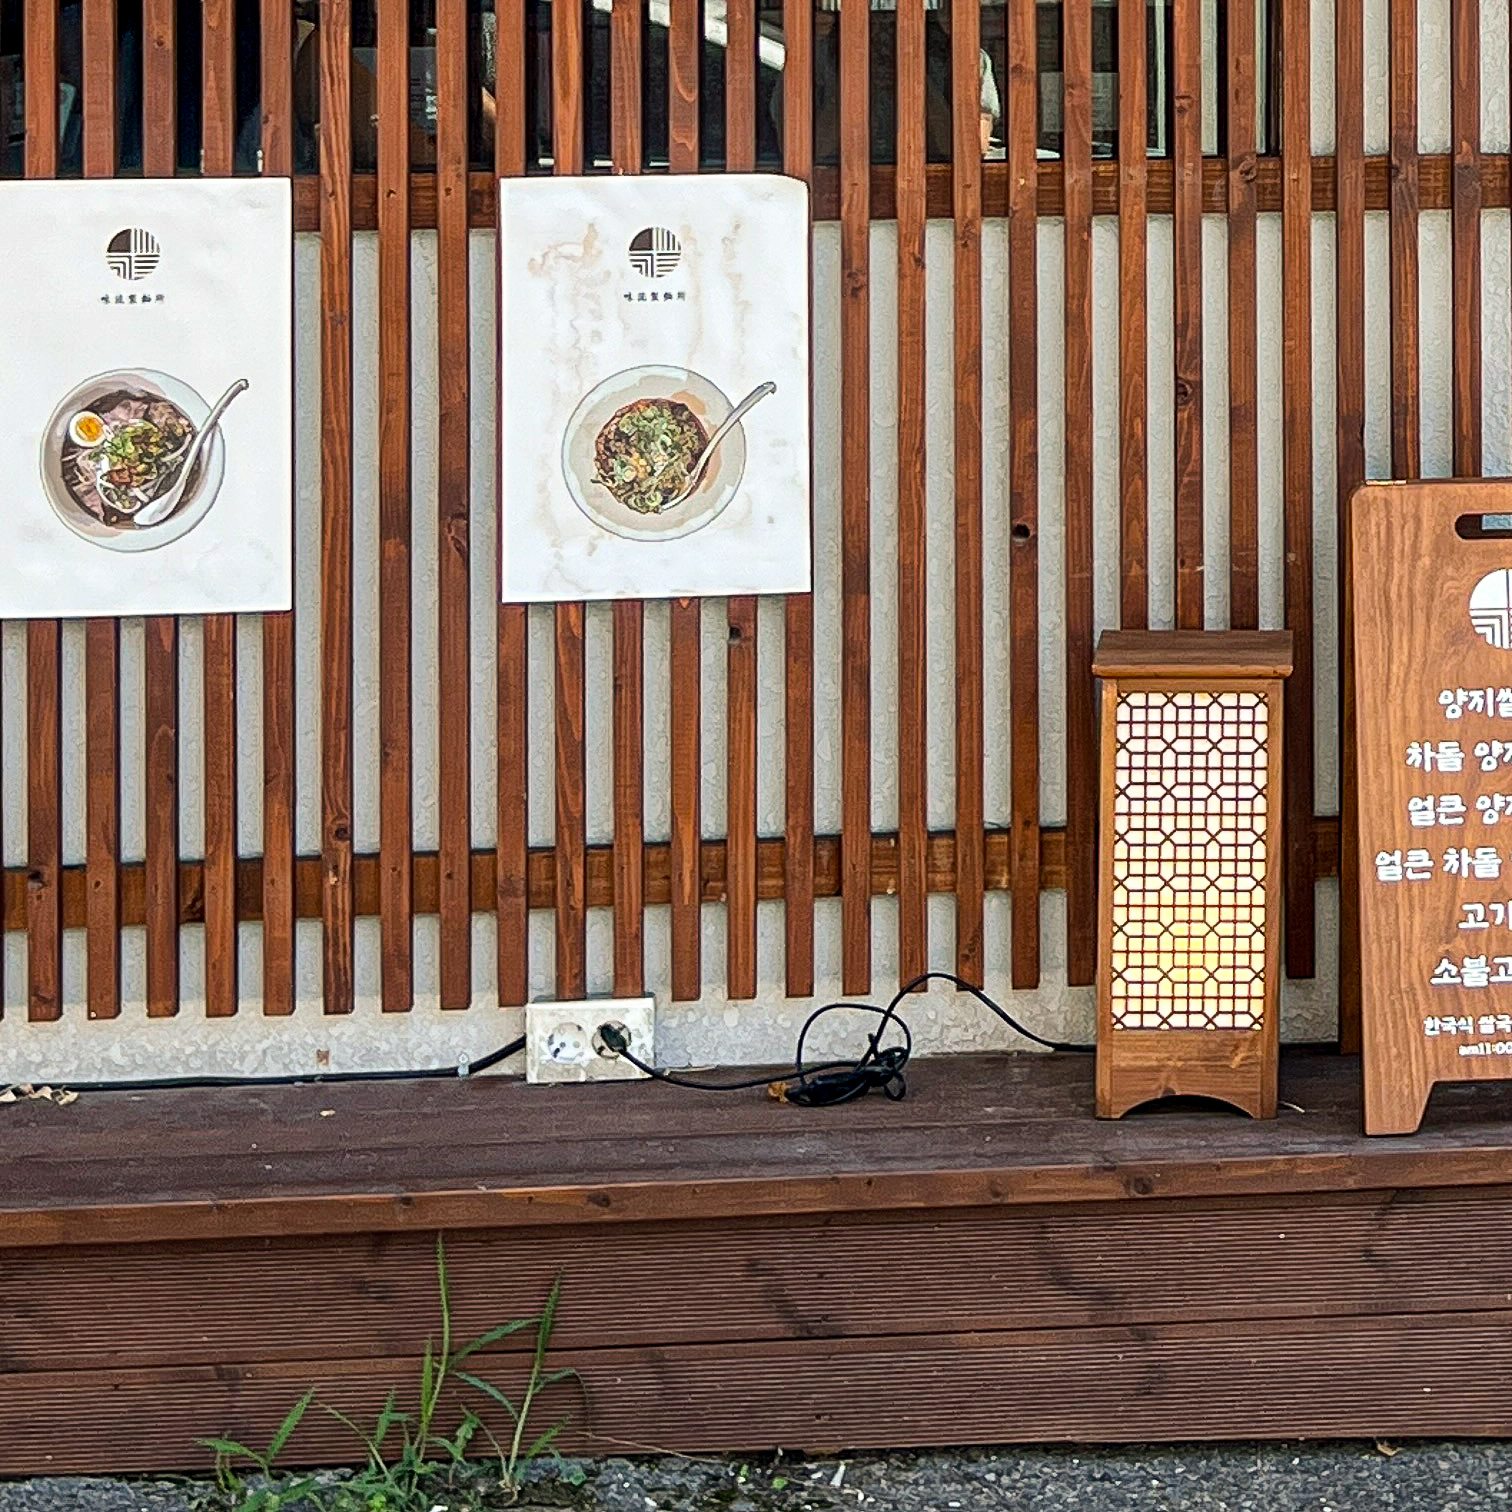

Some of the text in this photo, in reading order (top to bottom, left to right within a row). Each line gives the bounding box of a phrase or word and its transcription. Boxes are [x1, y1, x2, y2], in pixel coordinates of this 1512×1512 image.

[1406, 740, 1465, 773] 차돌
[1408, 793, 1467, 827] 얼큰
[1375, 848, 1434, 882] 얼큰
[1442, 846, 1502, 879] 차돌
[1423, 1015, 1474, 1036] 한국식
